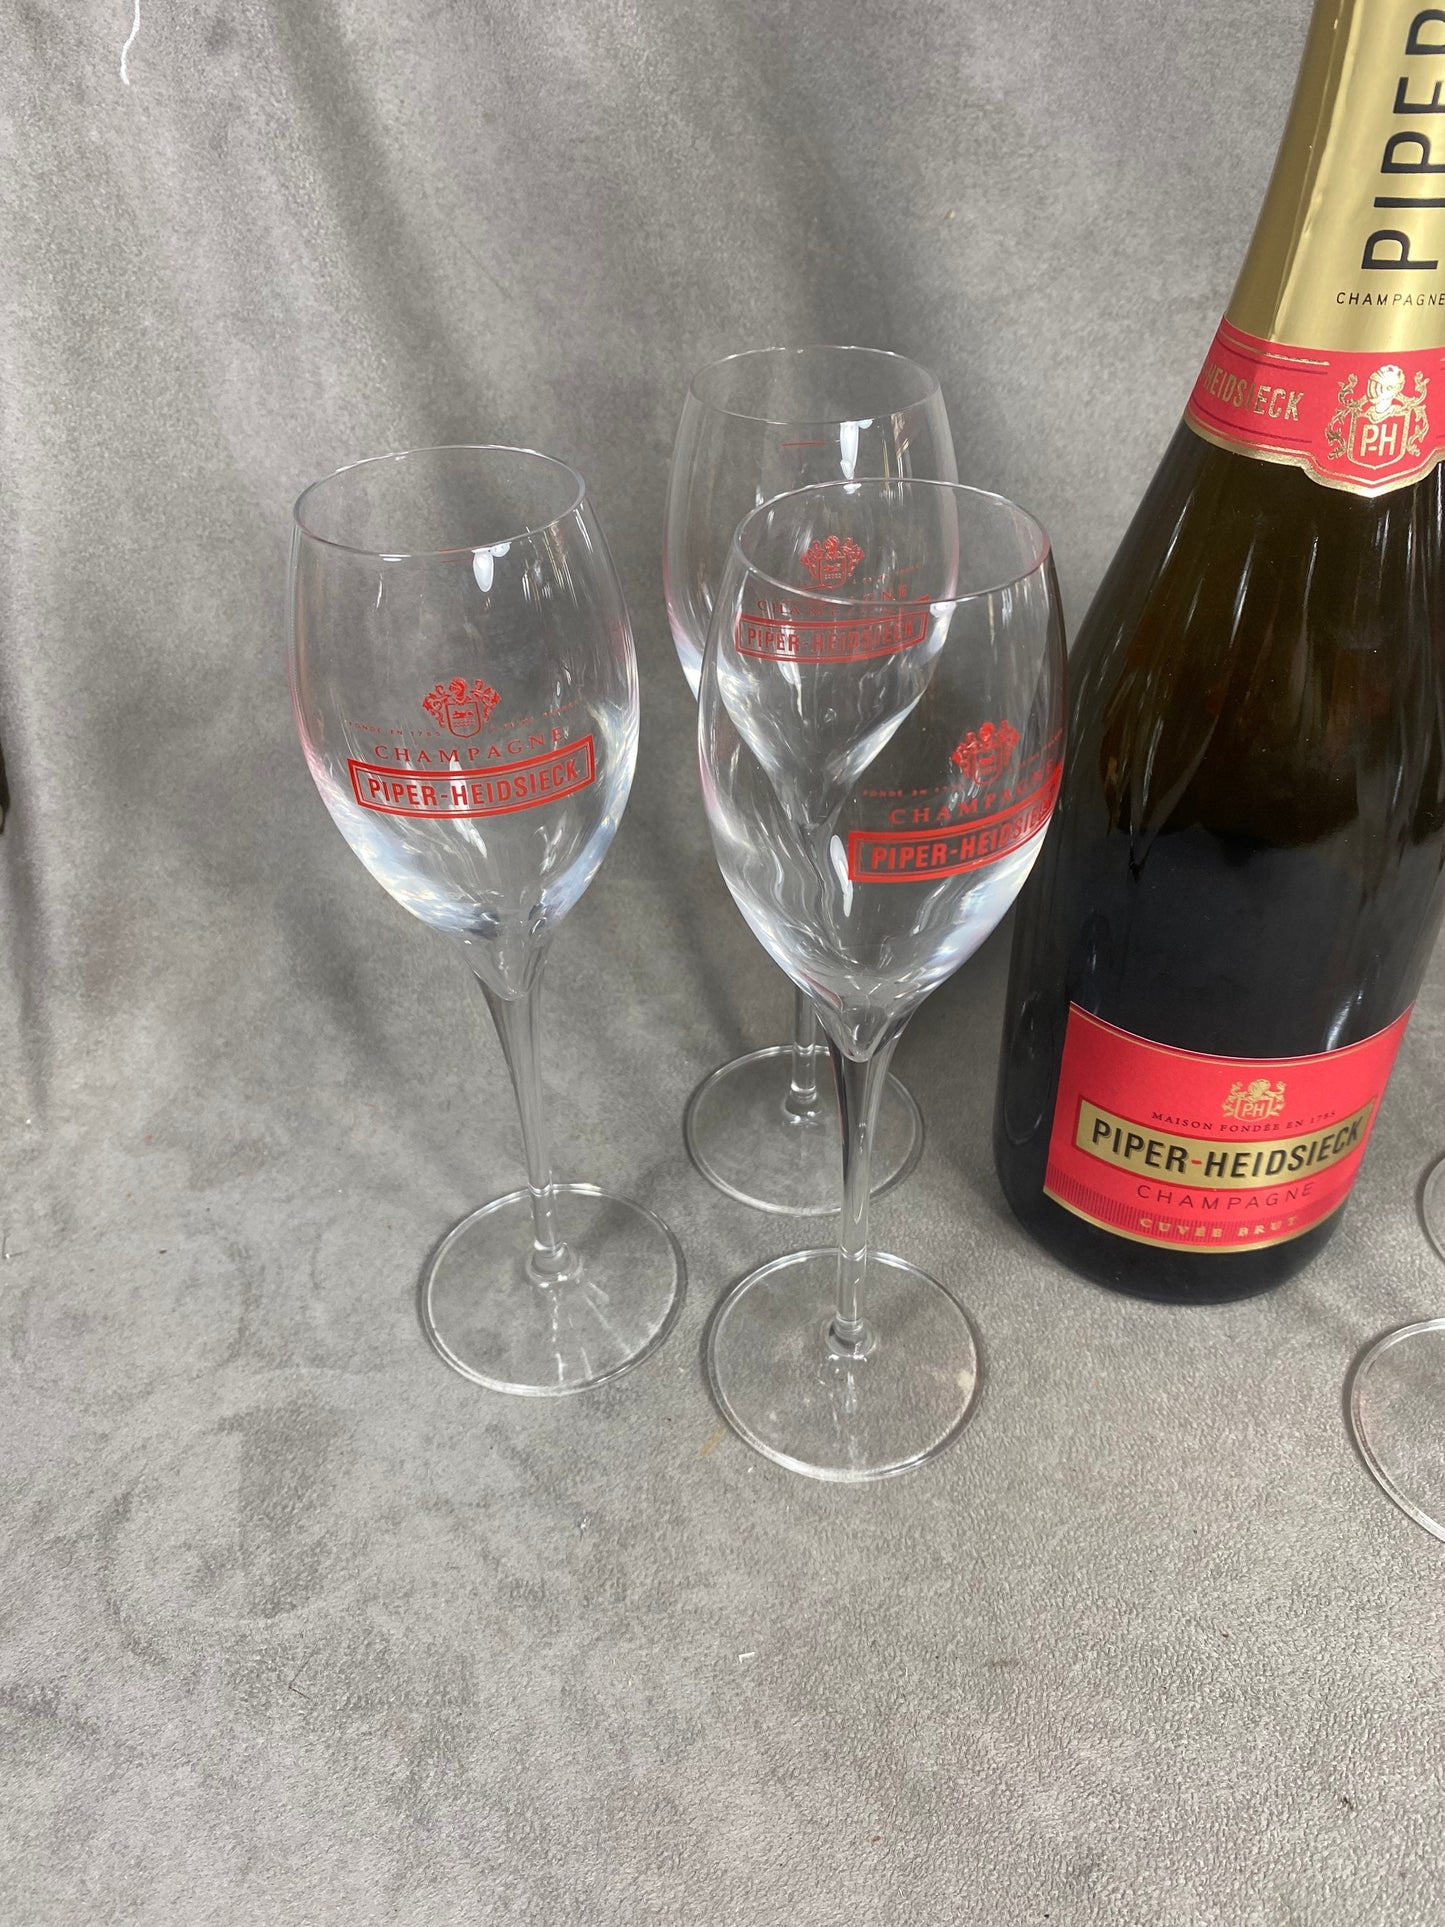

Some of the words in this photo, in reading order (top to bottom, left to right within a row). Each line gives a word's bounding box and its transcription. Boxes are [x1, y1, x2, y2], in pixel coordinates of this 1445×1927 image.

[1336, 292, 1445, 306] CHAMPAGNE
[1203, 363, 1304, 421] HEIDSIECK
[747, 619, 914, 653] PIPER-HEIDSIECK
[375, 726, 564, 762] CHAMPAGNE
[368, 759, 579, 806] PIPER-HEIDSIECK
[1151, 1111, 1213, 1130] MAISON
[1286, 1119, 1304, 1130] EN
[1092, 1117, 1364, 1178] PIPER-HEIDSIECK
[1137, 1181, 1314, 1210] CHAMPAGNE
[1237, 1216, 1299, 1237] BRUT
